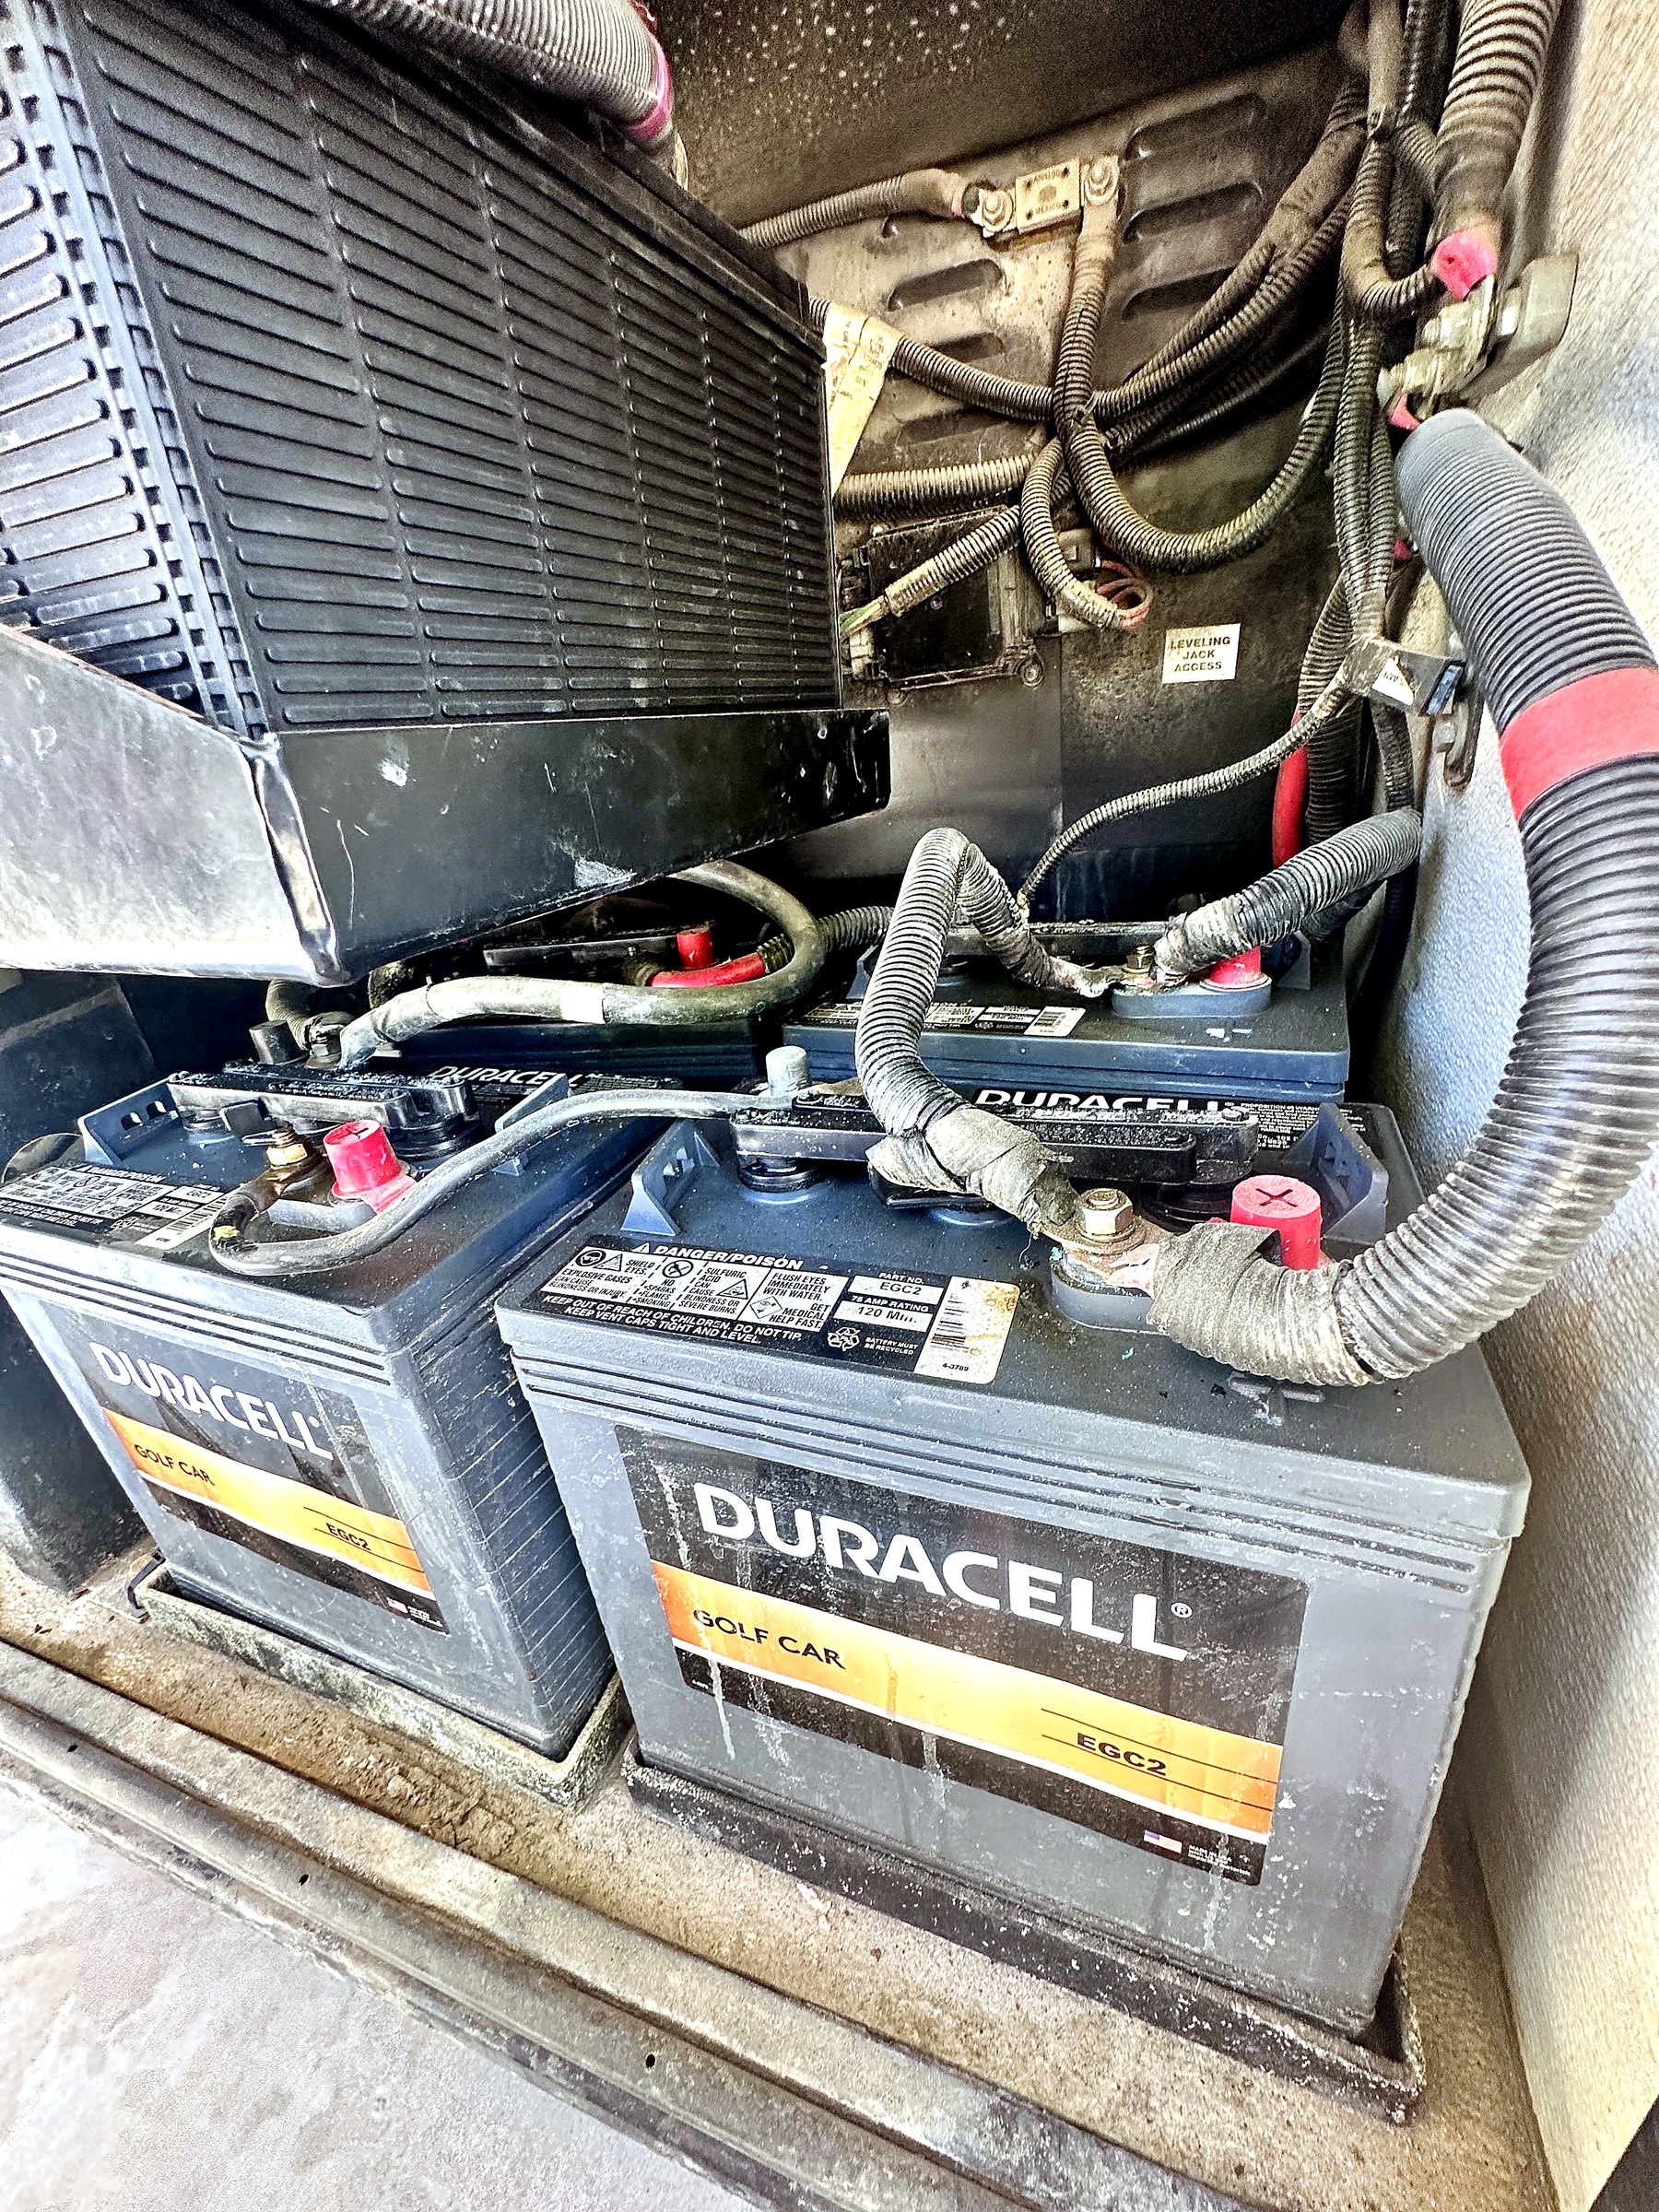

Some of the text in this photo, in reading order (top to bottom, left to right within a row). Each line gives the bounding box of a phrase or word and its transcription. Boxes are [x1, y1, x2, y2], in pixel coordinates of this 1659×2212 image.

[1170, 636, 1230, 650] LEVELING
[1182, 650, 1215, 660] JACK
[1174, 661, 1222, 672] ACCESS
[427, 1065, 583, 1088] DURACEL
[626, 1259, 655, 1269] SHIELD
[653, 1245, 804, 1270] DANGER/POISON
[561, 1268, 632, 1284] EXPLOSIVE GASES
[624, 1266, 647, 1276] EYES.
[704, 1267, 747, 1278] SULFURIC
[878, 1272, 925, 1284] PART NO.
[571, 1277, 594, 1286] CAUSE
[699, 1275, 721, 1283] ACID
[771, 1272, 827, 1285] FLUSH EYES
[548, 1281, 588, 1292] BLINDNESS
[688, 1288, 715, 1296] CAUSE
[763, 1286, 823, 1301] WITH WATER.
[767, 1279, 831, 1294] IMMEDIATELY
[879, 1281, 923, 1295] EGC2
[684, 1294, 727, 1305] BLINDNESS
[865, 1297, 888, 1306] AMP
[888, 1300, 929, 1312] RATING
[678, 1300, 737, 1314] SEVERE BURNS.
[810, 1303, 831, 1312] GET
[858, 1306, 883, 1318] 120
[542, 1295, 802, 1341] KEEP OUT OF REACH OF CHILDREN. DO NOT TIP.
[769, 1314, 822, 1329] HELP FAST.
[782, 1308, 827, 1321] MEDICAL
[564, 1306, 762, 1344] KEEP VENT CAPS TIGHT AND LEVEL.
[134, 1443, 216, 1486] GOLF CAR
[325, 1522, 371, 1551] EGC2
[693, 1609, 846, 1670] GOLF CAR
[1077, 1732, 1167, 1776] EGC2
